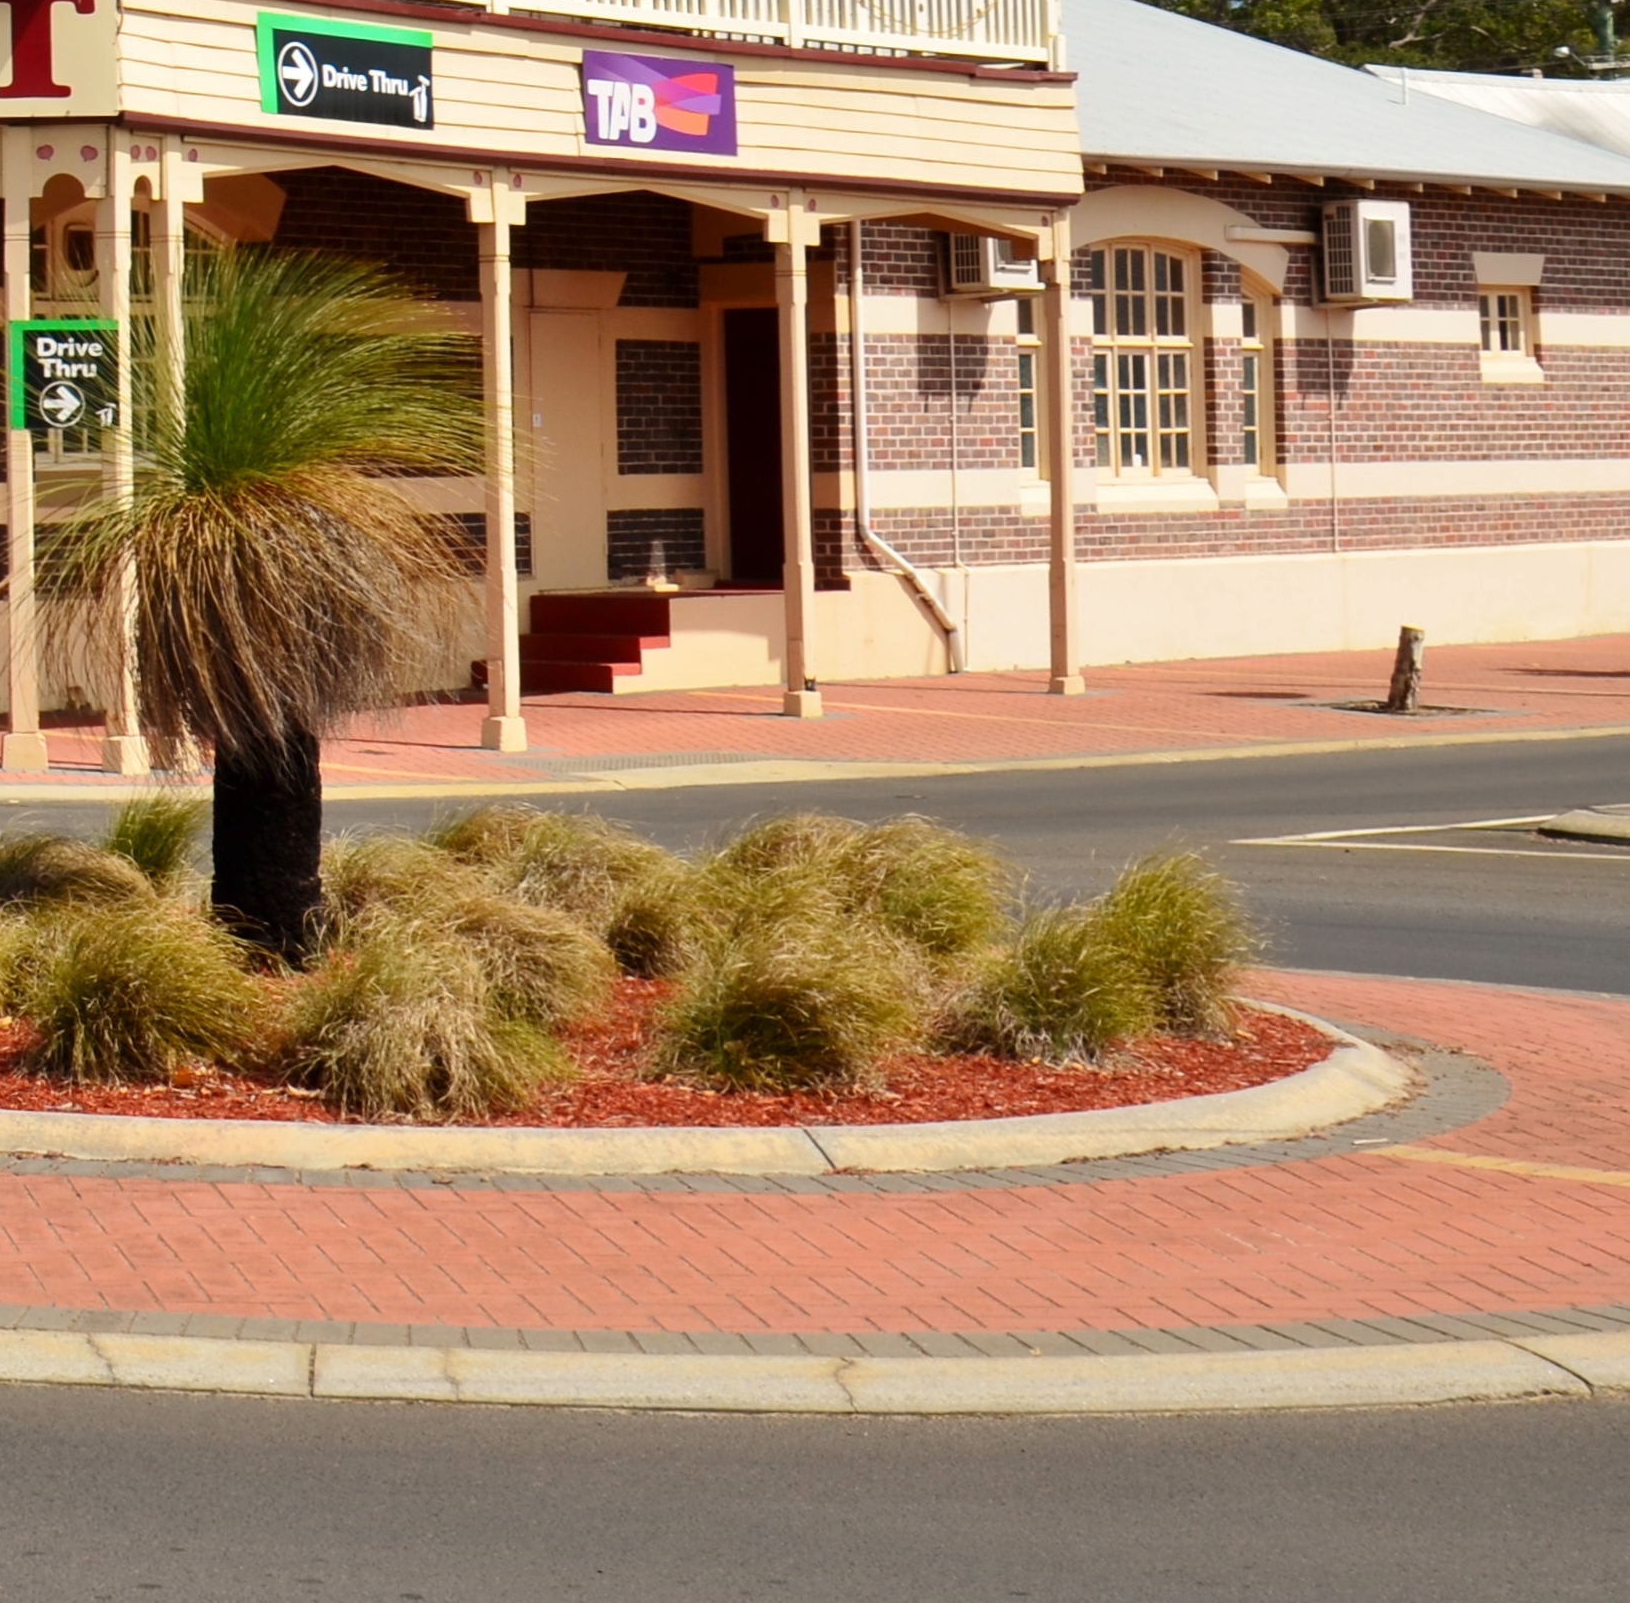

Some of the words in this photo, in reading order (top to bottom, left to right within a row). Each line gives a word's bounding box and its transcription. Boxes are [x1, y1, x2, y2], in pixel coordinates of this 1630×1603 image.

[321, 64, 369, 92] Drive
[369, 69, 409, 97] Thru
[587, 78, 656, 143] TAB
[36, 337, 103, 357] Drive
[38, 358, 98, 378] Thru
